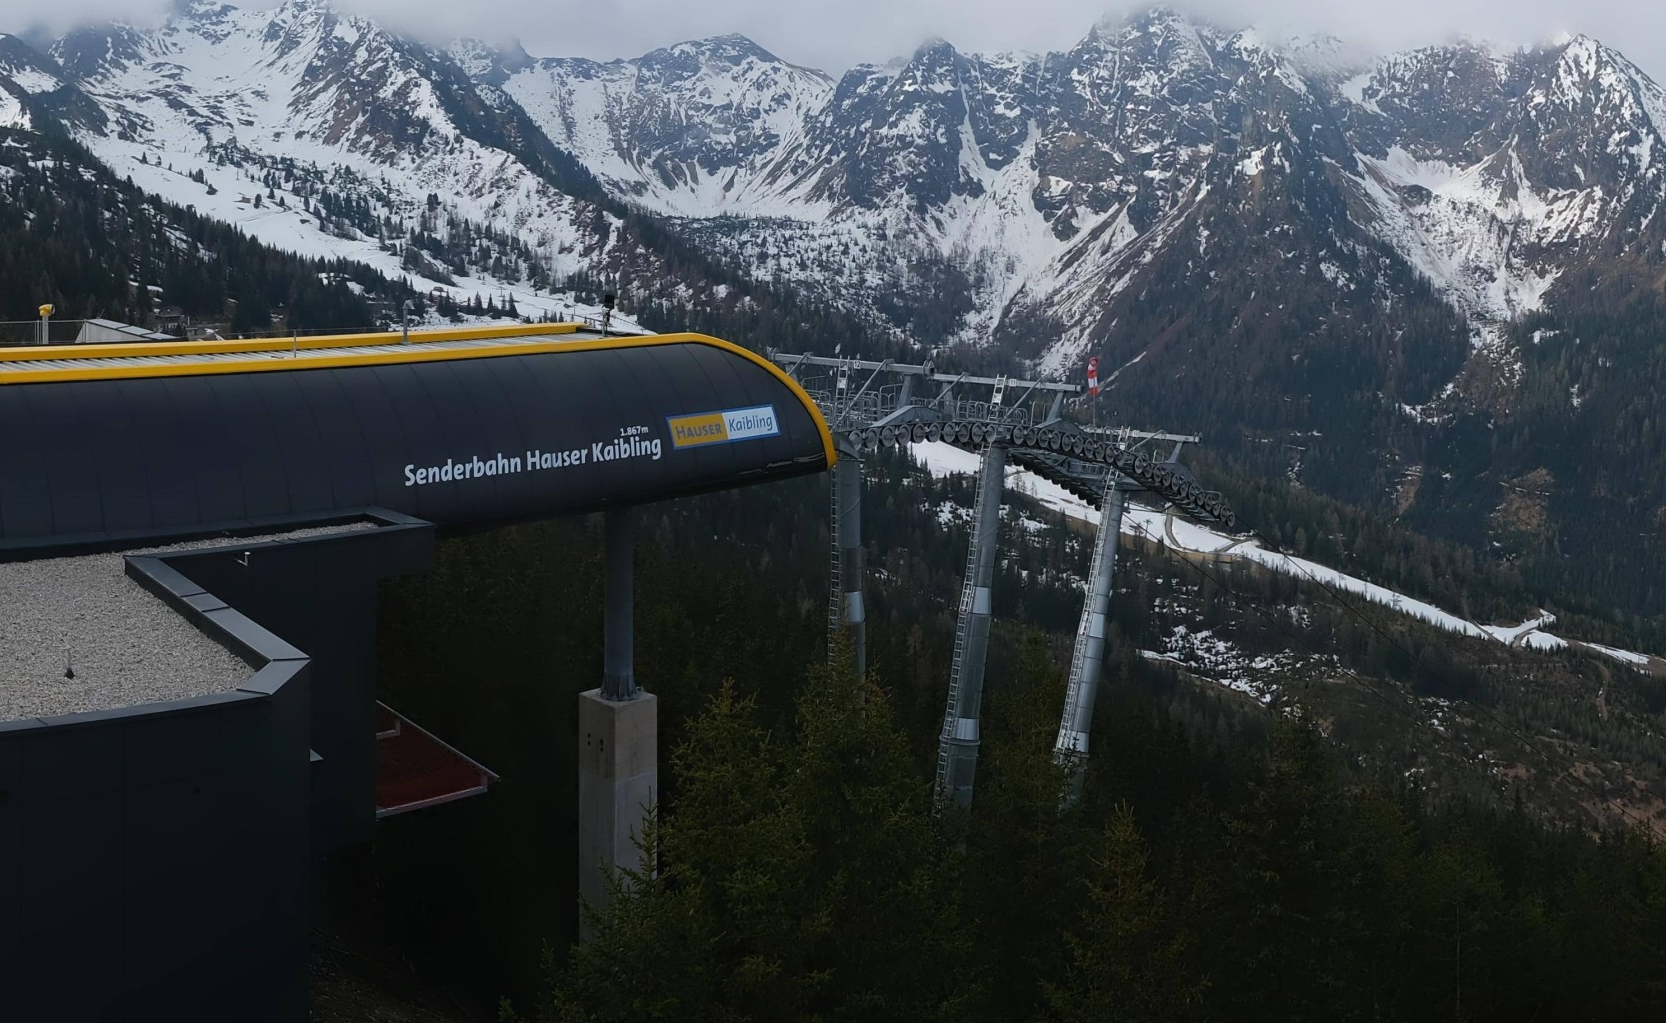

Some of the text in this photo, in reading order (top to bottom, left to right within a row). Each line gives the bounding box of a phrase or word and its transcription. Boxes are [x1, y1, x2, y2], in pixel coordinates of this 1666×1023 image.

[620, 425, 649, 437] 1.867m
[675, 415, 773, 440] HAUSER Kaibling
[404, 436, 662, 486] Senderbahn Hauser Kaibling
